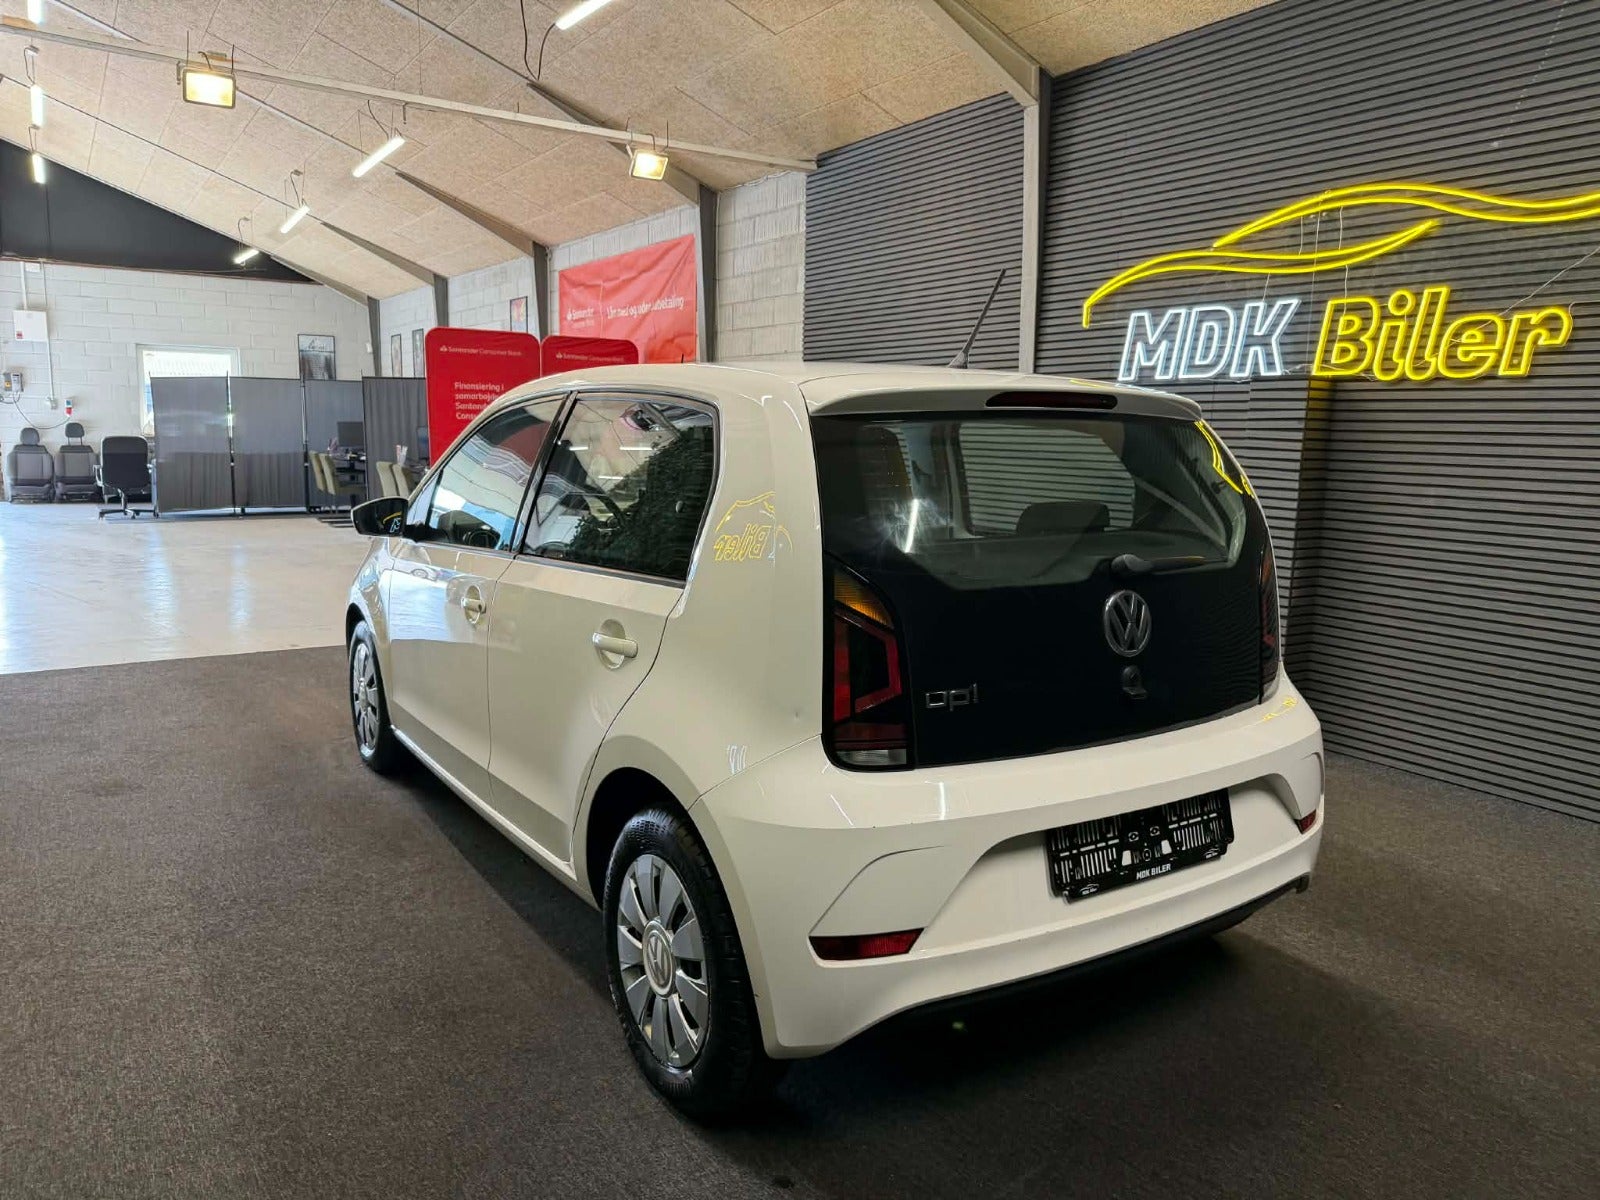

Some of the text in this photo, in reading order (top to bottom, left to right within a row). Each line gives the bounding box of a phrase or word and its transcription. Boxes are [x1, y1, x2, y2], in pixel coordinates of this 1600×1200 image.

[1118, 286, 1573, 382] MDK Biler
[454, 381, 501, 392] Finansiering
[1136, 864, 1171, 880] MDK BILER
